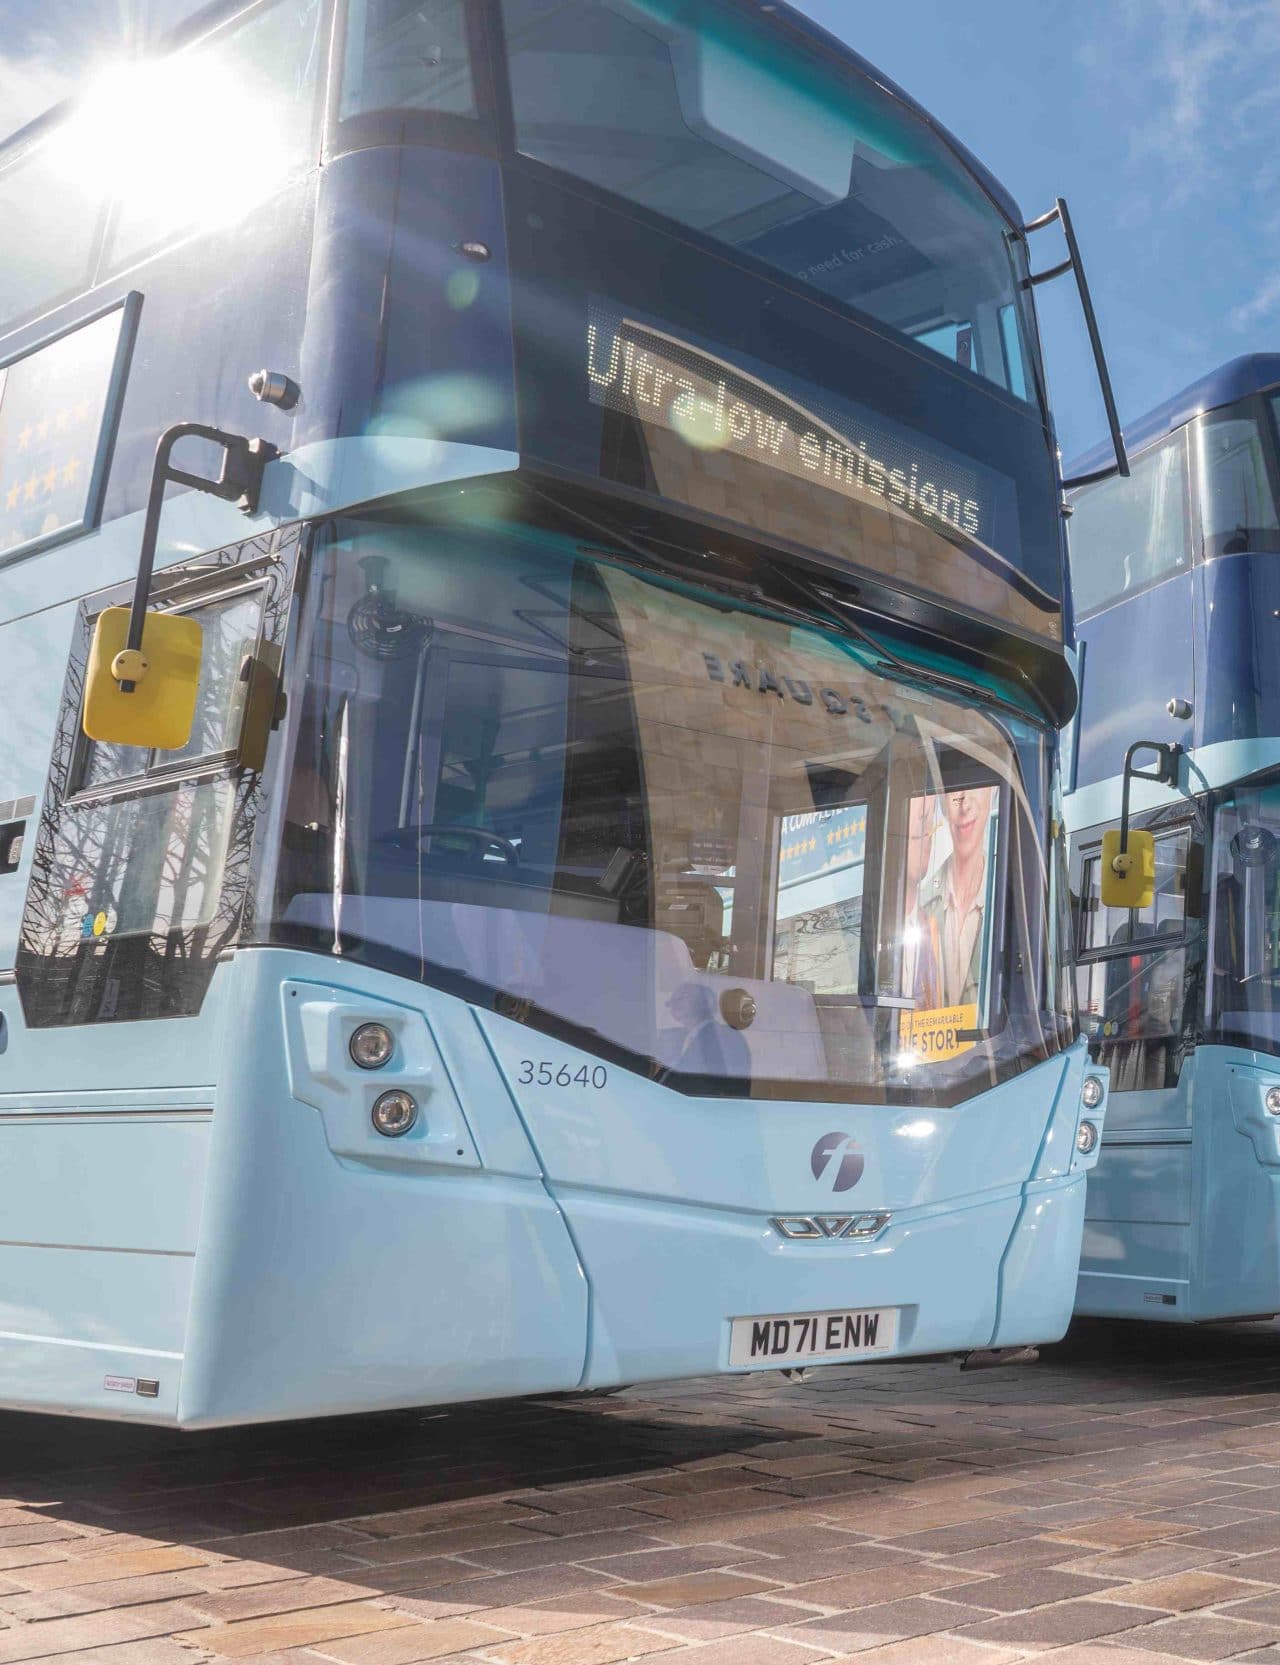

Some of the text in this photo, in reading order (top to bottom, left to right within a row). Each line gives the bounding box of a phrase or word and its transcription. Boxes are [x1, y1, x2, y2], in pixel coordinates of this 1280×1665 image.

[841, 247, 865, 262] for
[587, 324, 980, 534] Ultra-low emissions
[517, 1060, 608, 1089] 35640
[750, 1313, 880, 1357] MD71 ENW
